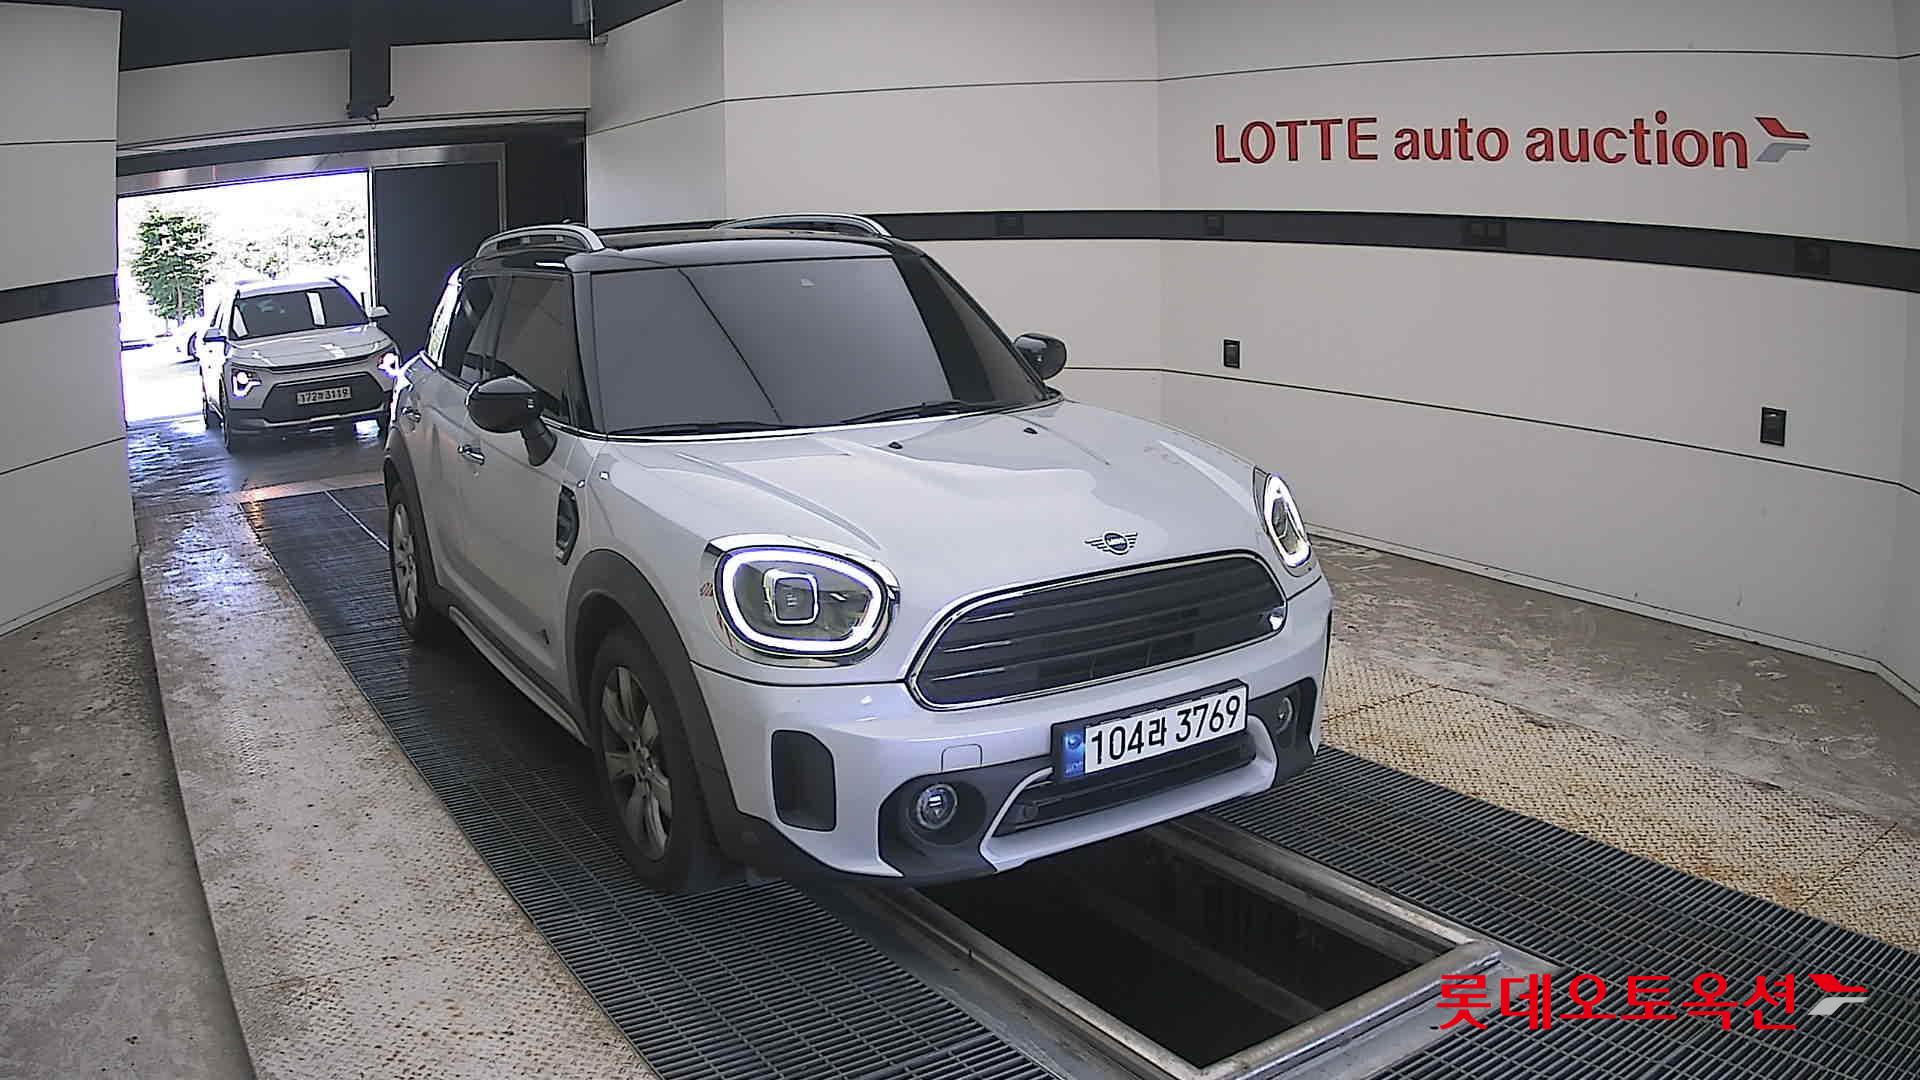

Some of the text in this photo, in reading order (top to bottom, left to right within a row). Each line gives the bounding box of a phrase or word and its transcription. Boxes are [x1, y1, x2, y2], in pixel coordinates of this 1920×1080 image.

[1215, 110, 1749, 169] LOTTE auto auction
[1091, 695, 1241, 765] 104라 3769
